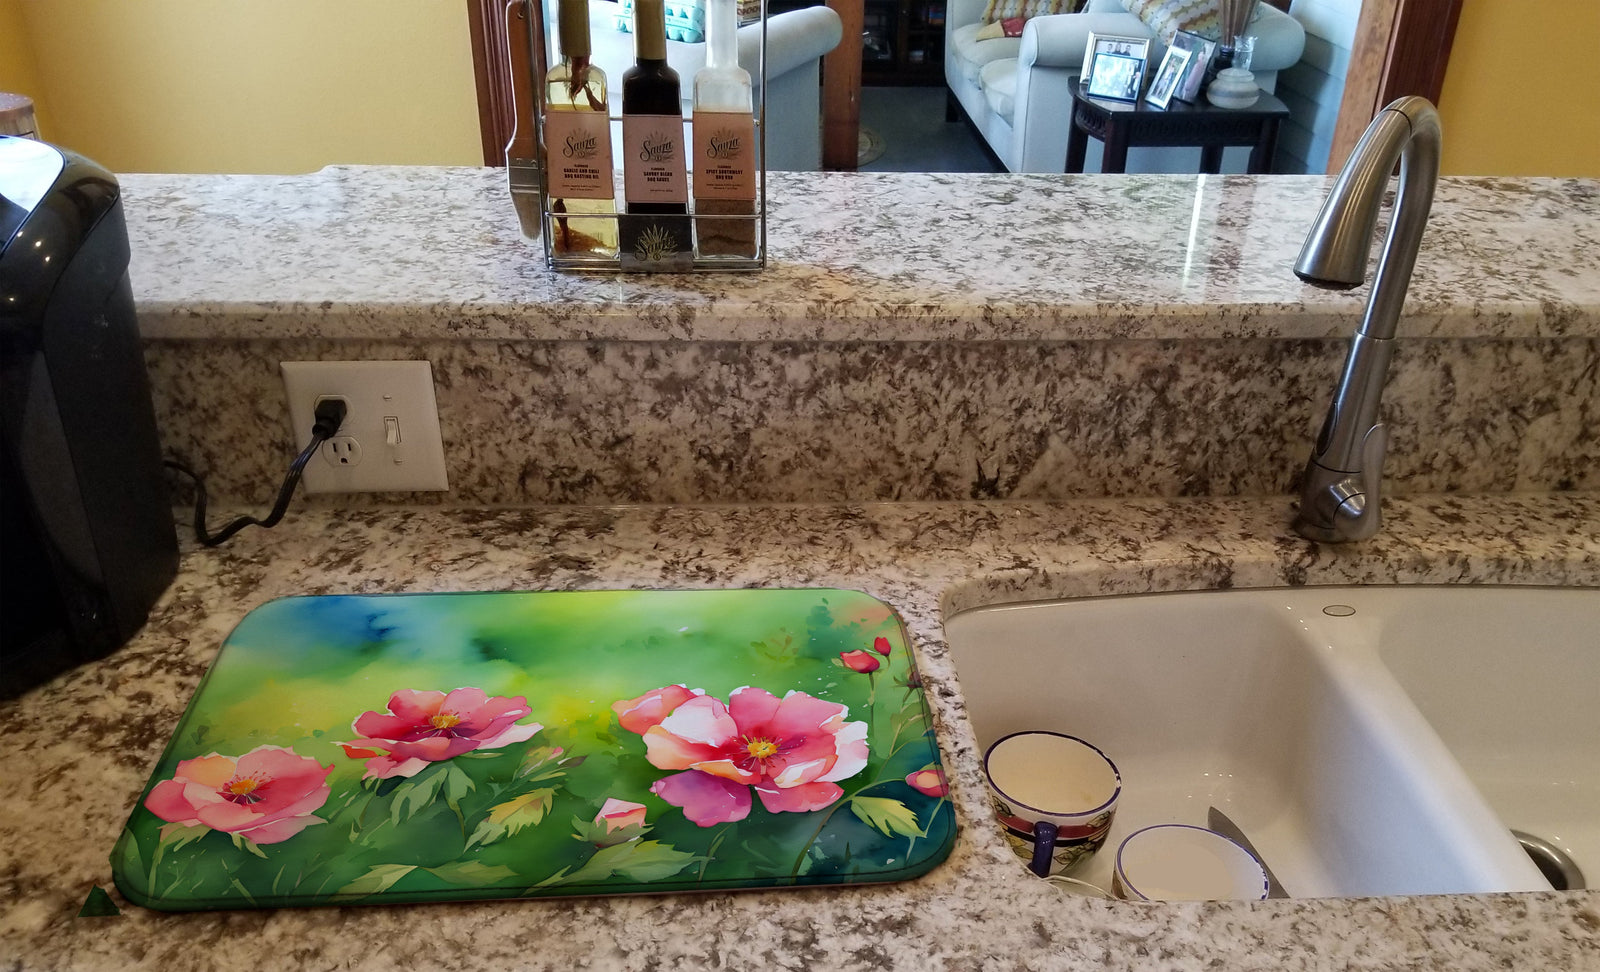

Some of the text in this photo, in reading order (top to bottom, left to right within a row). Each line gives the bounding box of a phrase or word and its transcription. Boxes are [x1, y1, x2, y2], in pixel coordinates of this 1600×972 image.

[563, 136, 598, 159] Sauza
[640, 140, 673, 161] Sauza
[707, 137, 740, 159] Sauza
